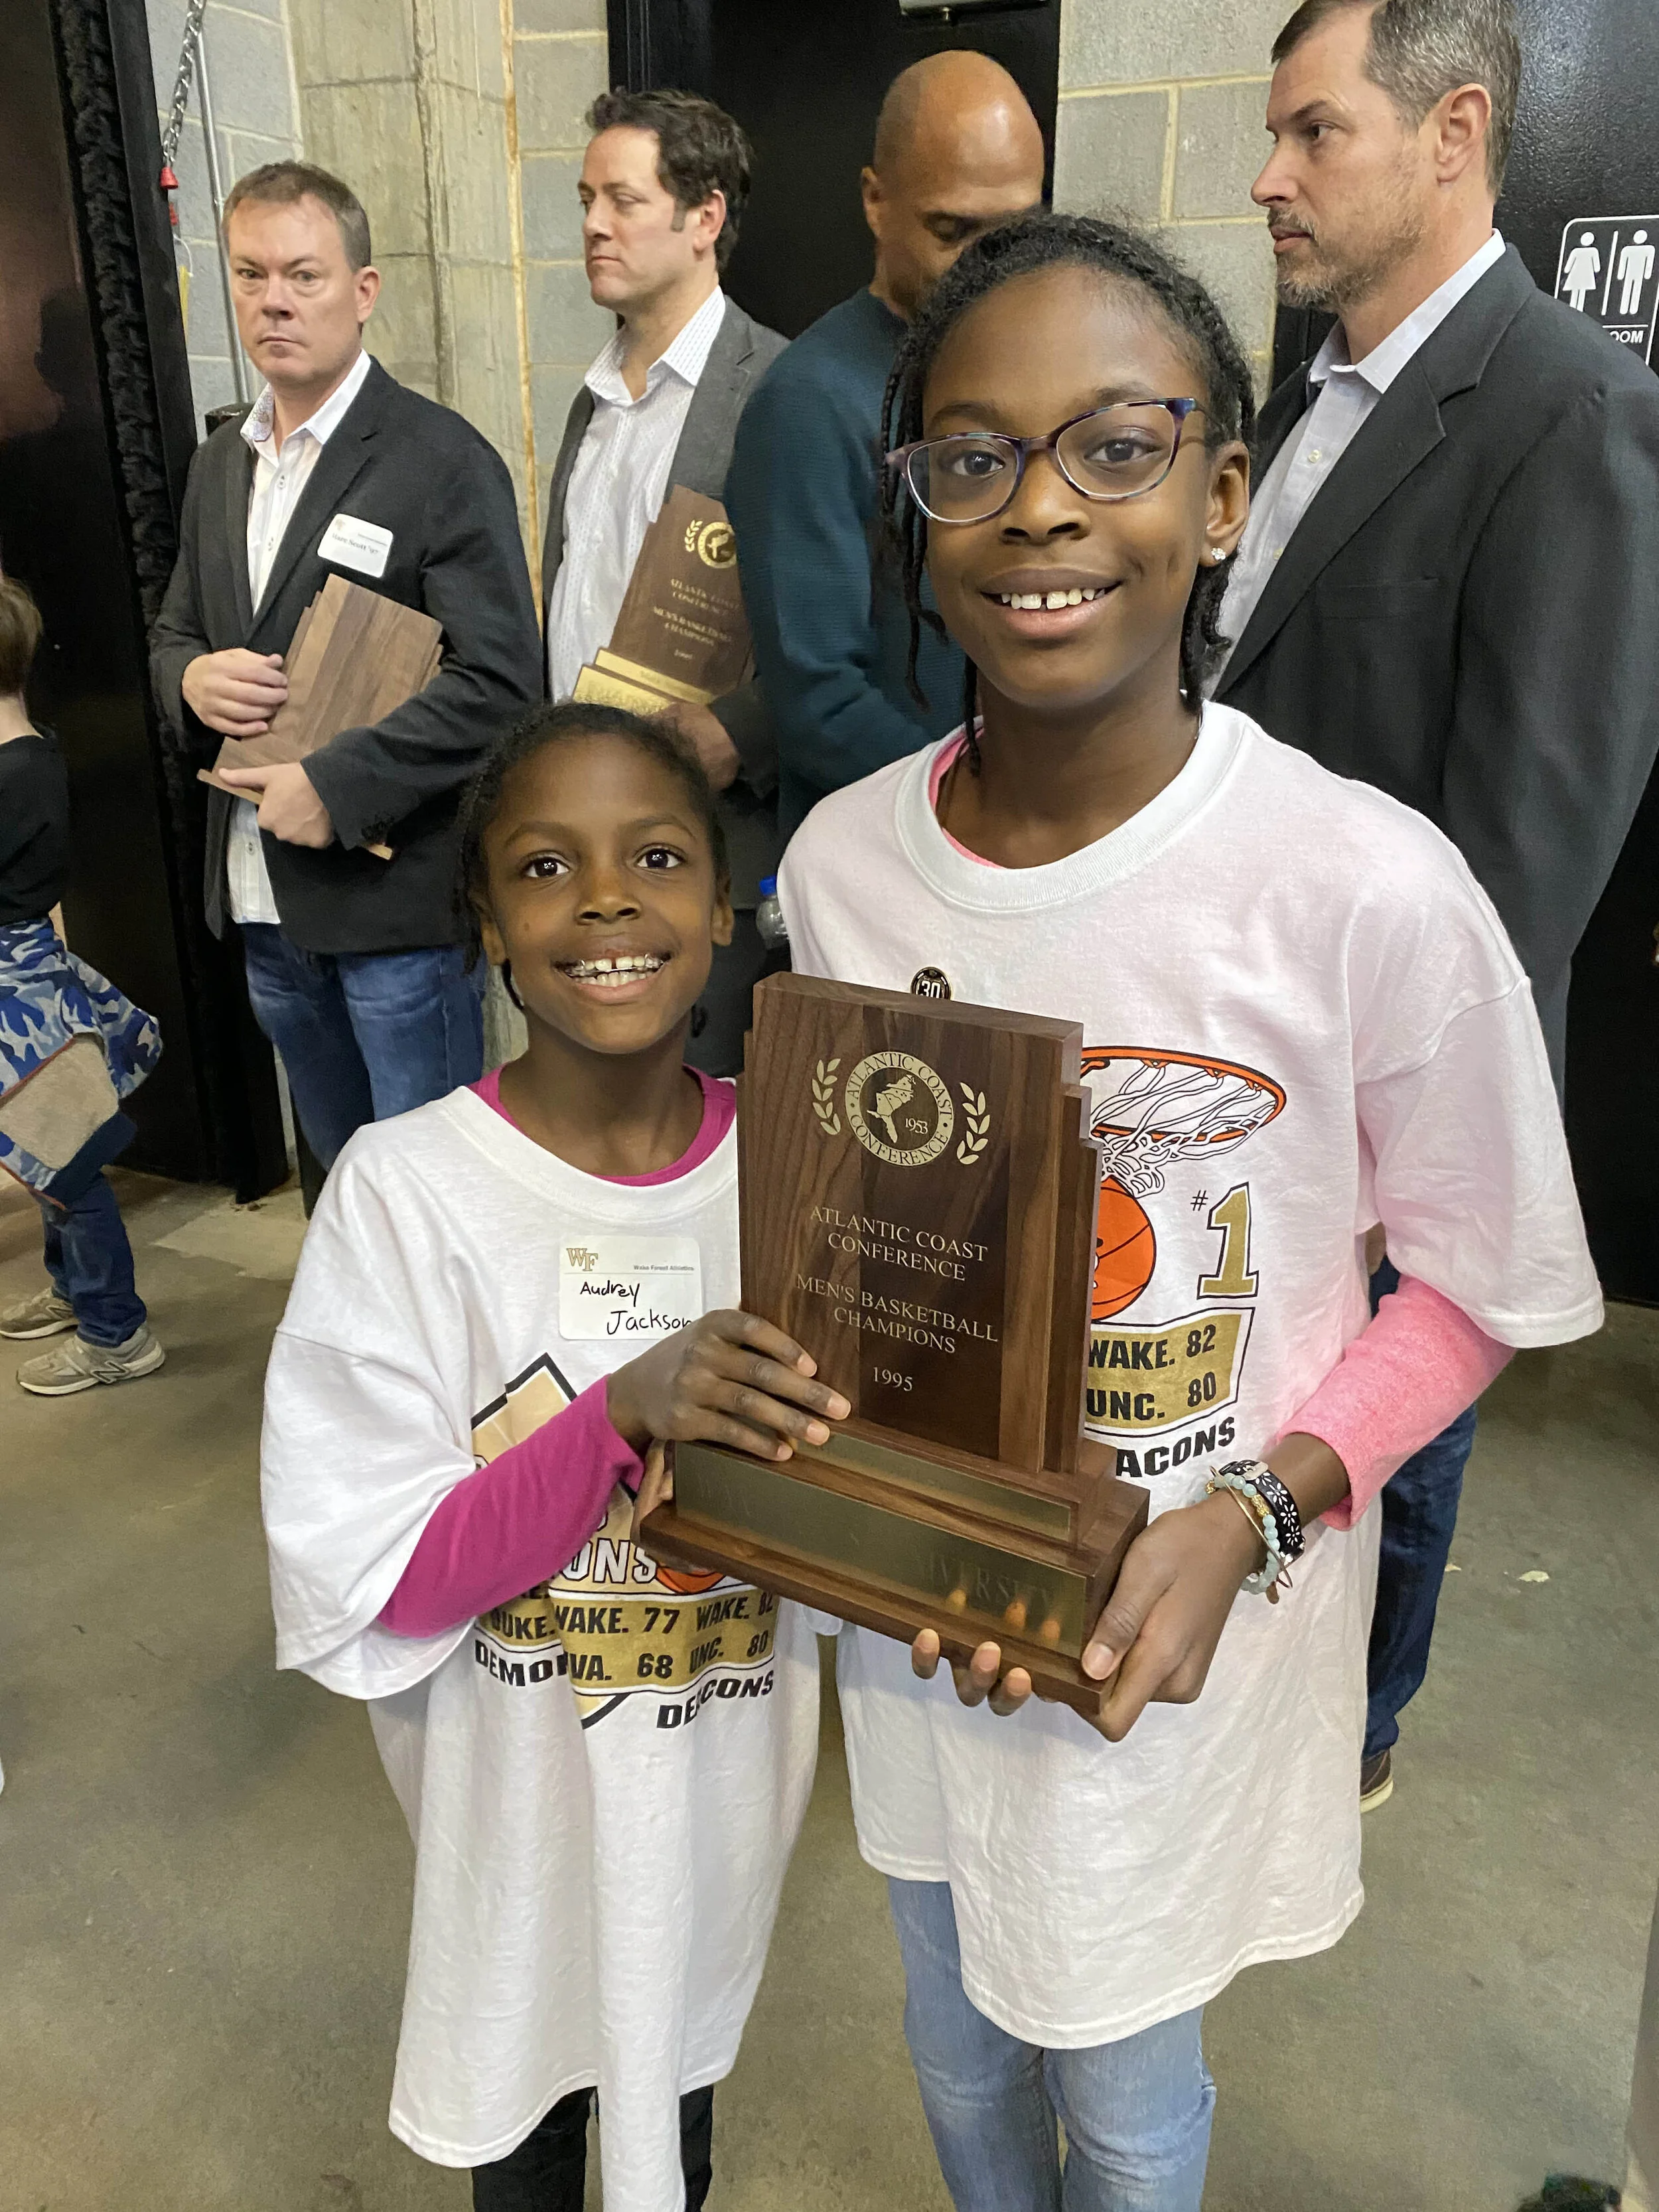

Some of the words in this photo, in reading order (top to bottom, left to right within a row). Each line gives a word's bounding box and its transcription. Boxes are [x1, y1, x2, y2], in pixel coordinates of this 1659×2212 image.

[847, 1053, 914, 1100] ATLANTIC
[918, 1066, 954, 1120] COAST
[850, 1114, 949, 1165] CONFERENCE
[904, 1118, 928, 1135] 1953
[810, 1205, 910, 1243] ATLANTIC
[916, 1230, 988, 1262] COAST
[828, 1232, 966, 1281] CONFERENCE
[566, 1248, 599, 1272] WF
[579, 1280, 640, 1307] Audrey
[796, 1274, 855, 1303] MEN'S
[861, 1291, 999, 1342] BASKETBALL
[833, 1307, 956, 1354] CHAMPIONS
[1088, 1339, 1175, 1370] WAKE.
[1186, 1323, 1216, 1358] 82
[873, 1366, 913, 1392] 1995
[1086, 1388, 1165, 1421] UNC.
[1187, 1371, 1216, 1408] 80
[644, 1607, 680, 1635] 77
[697, 1595, 749, 1632] WAKE.
[569, 1653, 613, 1681] VA.
[637, 1653, 674, 1679] 68
[689, 1637, 724, 1674] UNC.
[747, 1629, 768, 1658] 80
